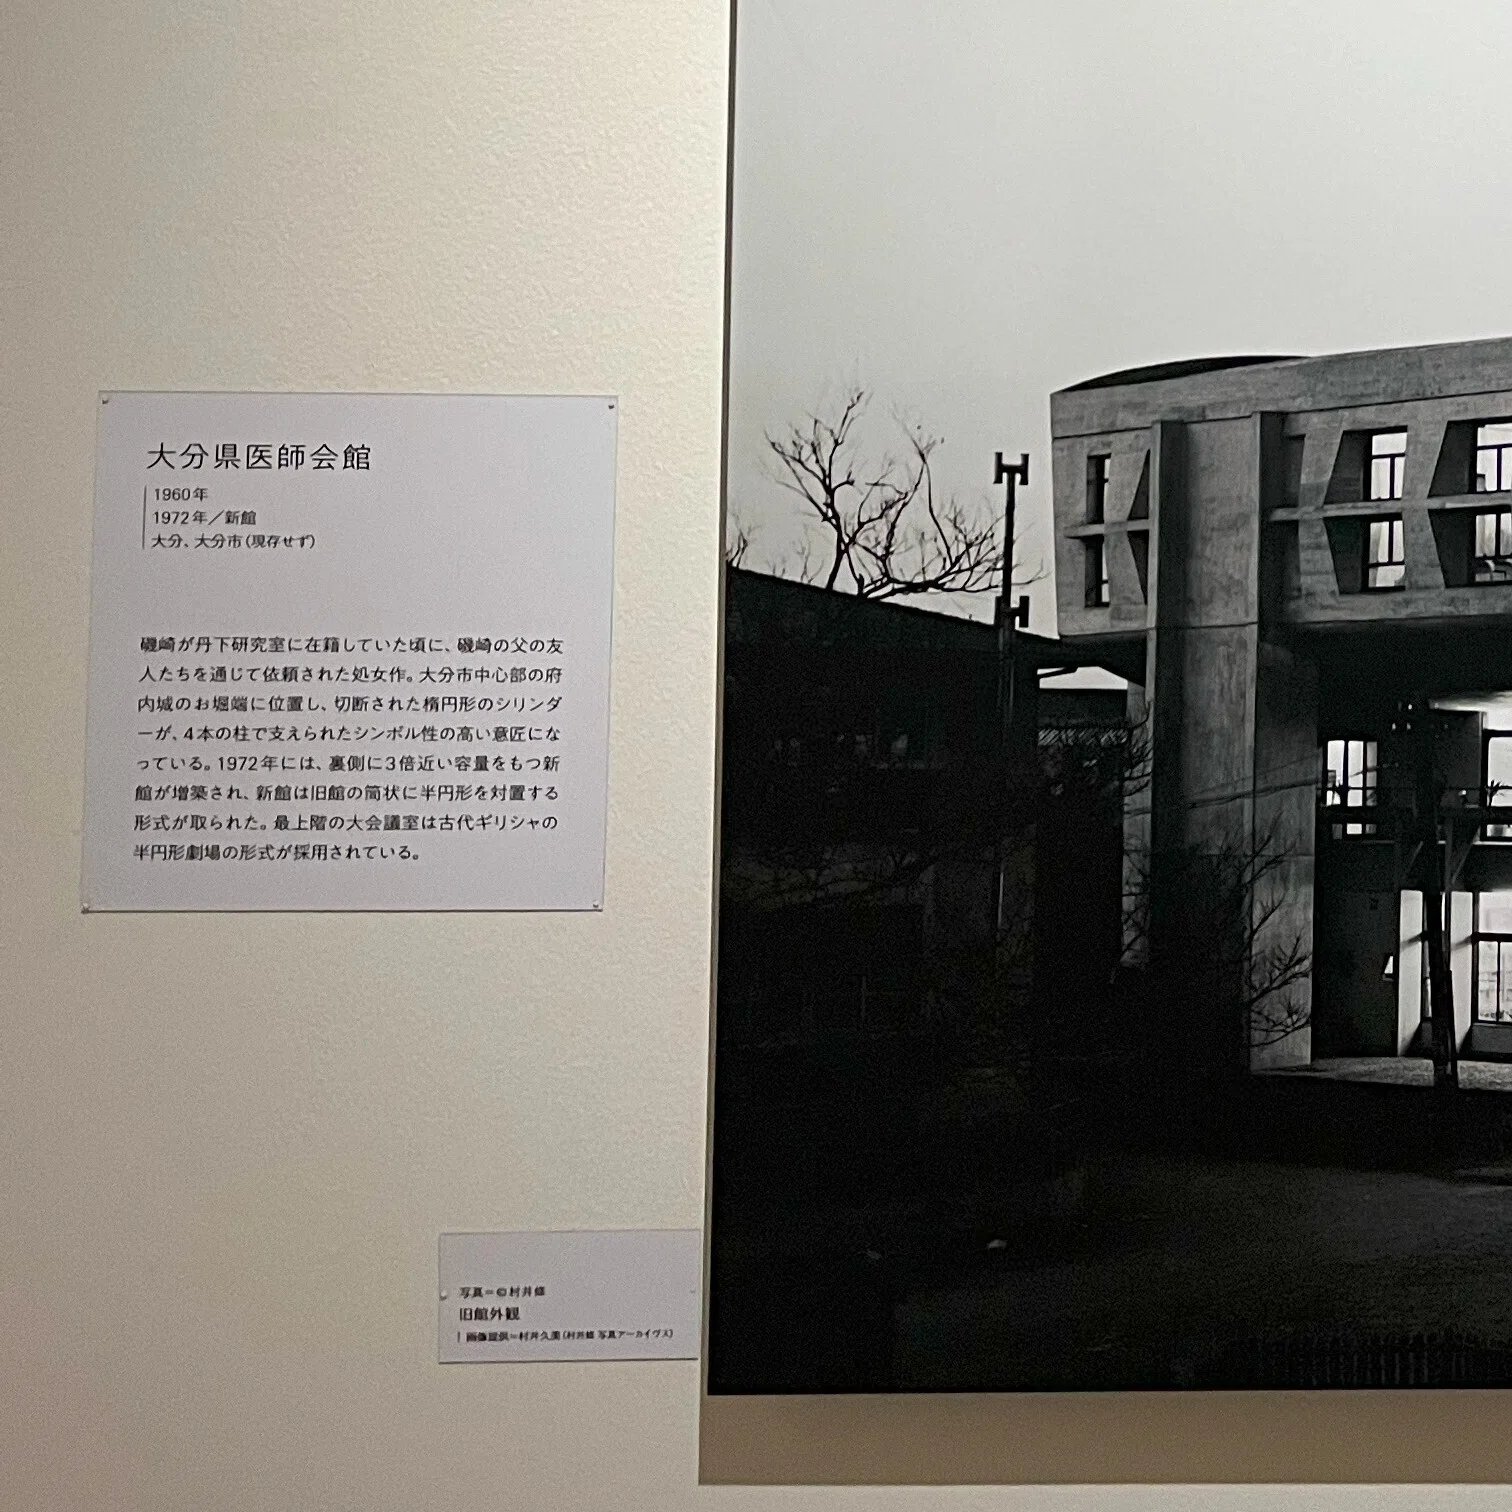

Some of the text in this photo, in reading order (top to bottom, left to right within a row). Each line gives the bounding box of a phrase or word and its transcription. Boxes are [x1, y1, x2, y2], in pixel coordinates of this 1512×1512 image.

[146, 442, 371, 471] 大分県医師会館
[154, 488, 209, 502] 1960年
[153, 510, 257, 525] 1972年／新館
[138, 666, 563, 683] 人たちを通じて依頼された処女作。大分市中心部の府
[135, 784, 559, 802] 館が増築され、新館は旧館の筒状に半円形を対置する
[133, 814, 558, 831] 形式が取られた。最上階の大会議室は古代ギリシャの
[133, 843, 420, 861] 半円形劇場の形式が採用されている。
[459, 1306, 521, 1321] 旧館外観
